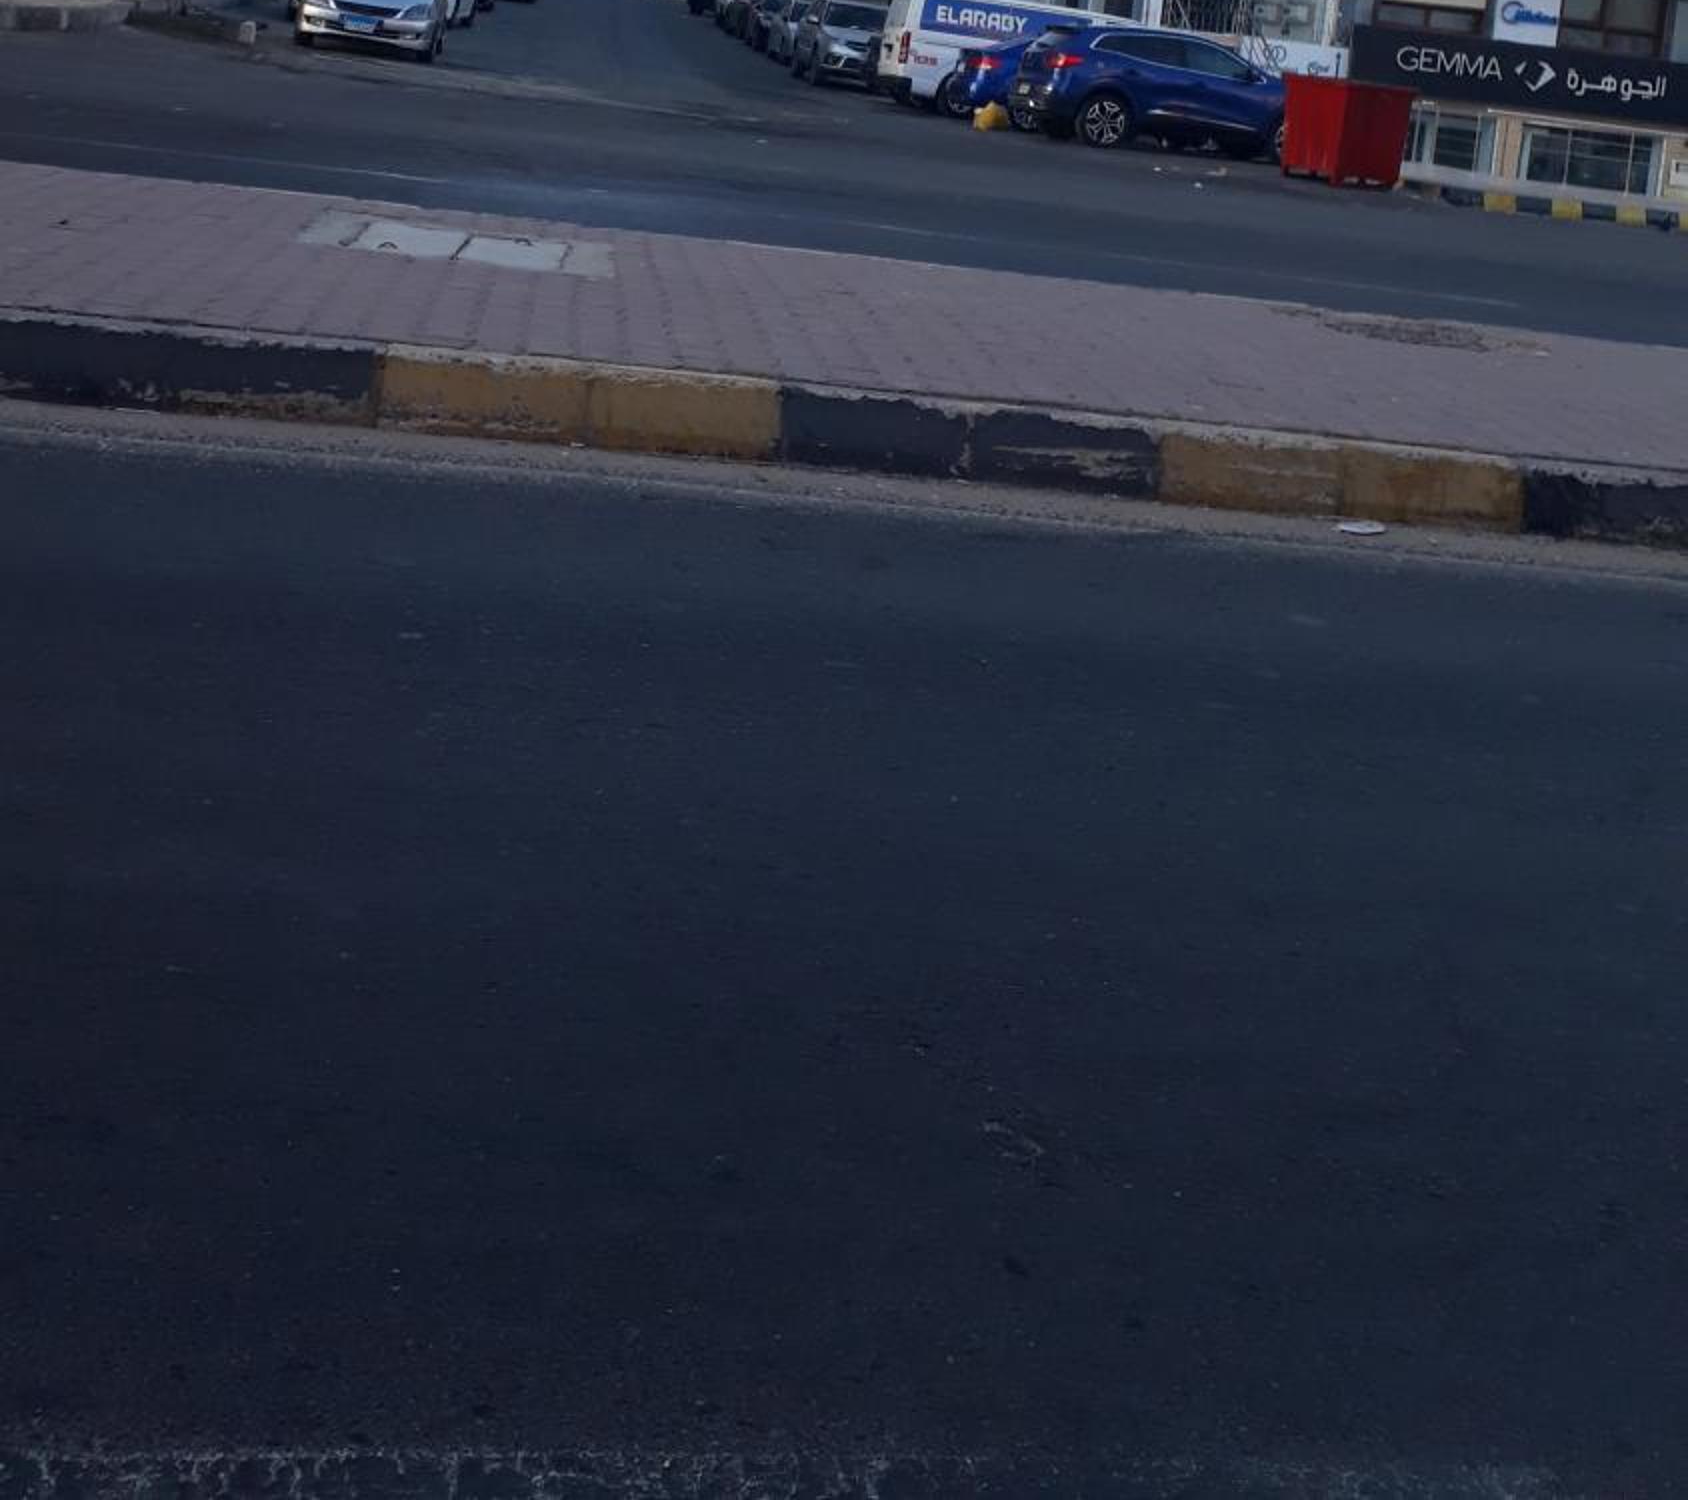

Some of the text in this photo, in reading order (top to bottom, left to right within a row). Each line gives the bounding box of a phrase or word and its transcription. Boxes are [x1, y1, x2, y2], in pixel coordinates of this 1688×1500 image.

[935, 4, 1029, 34] ELARABY
[1396, 45, 1503, 81] GEMMA
[1566, 67, 1667, 101] الجوهرة
